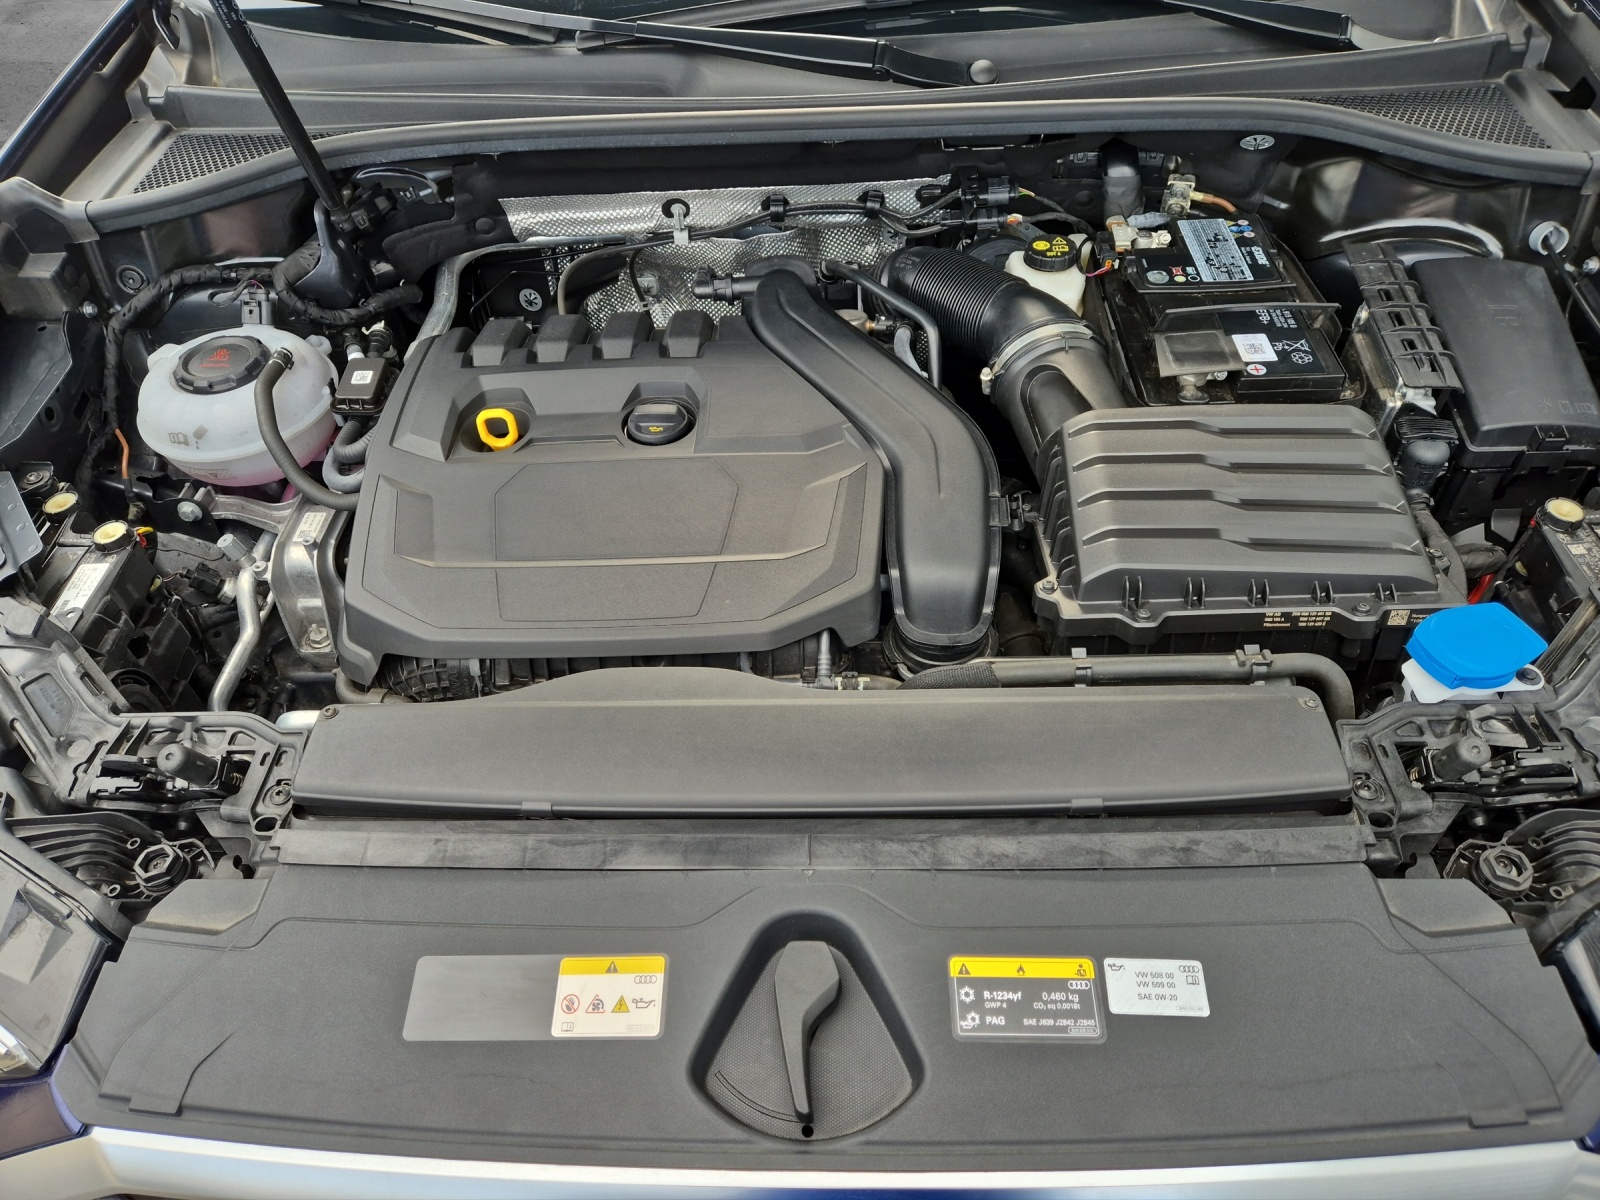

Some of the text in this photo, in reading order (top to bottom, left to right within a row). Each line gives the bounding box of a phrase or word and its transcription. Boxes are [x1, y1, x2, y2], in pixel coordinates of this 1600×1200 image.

[1134, 971, 1149, 979] VW
[1164, 972, 1175, 980] 00
[1136, 980, 1176, 989] VW 509 00
[983, 990, 1022, 1002] R-1234yf
[1042, 991, 1079, 1003] 0,460 kg
[1137, 993, 1178, 1001] SAE 0W-20
[984, 1001, 1007, 1009] GWP 4
[985, 1015, 1006, 1026] PAG
[1023, 1018, 1096, 1027] SAE J639 J2842 J2845
